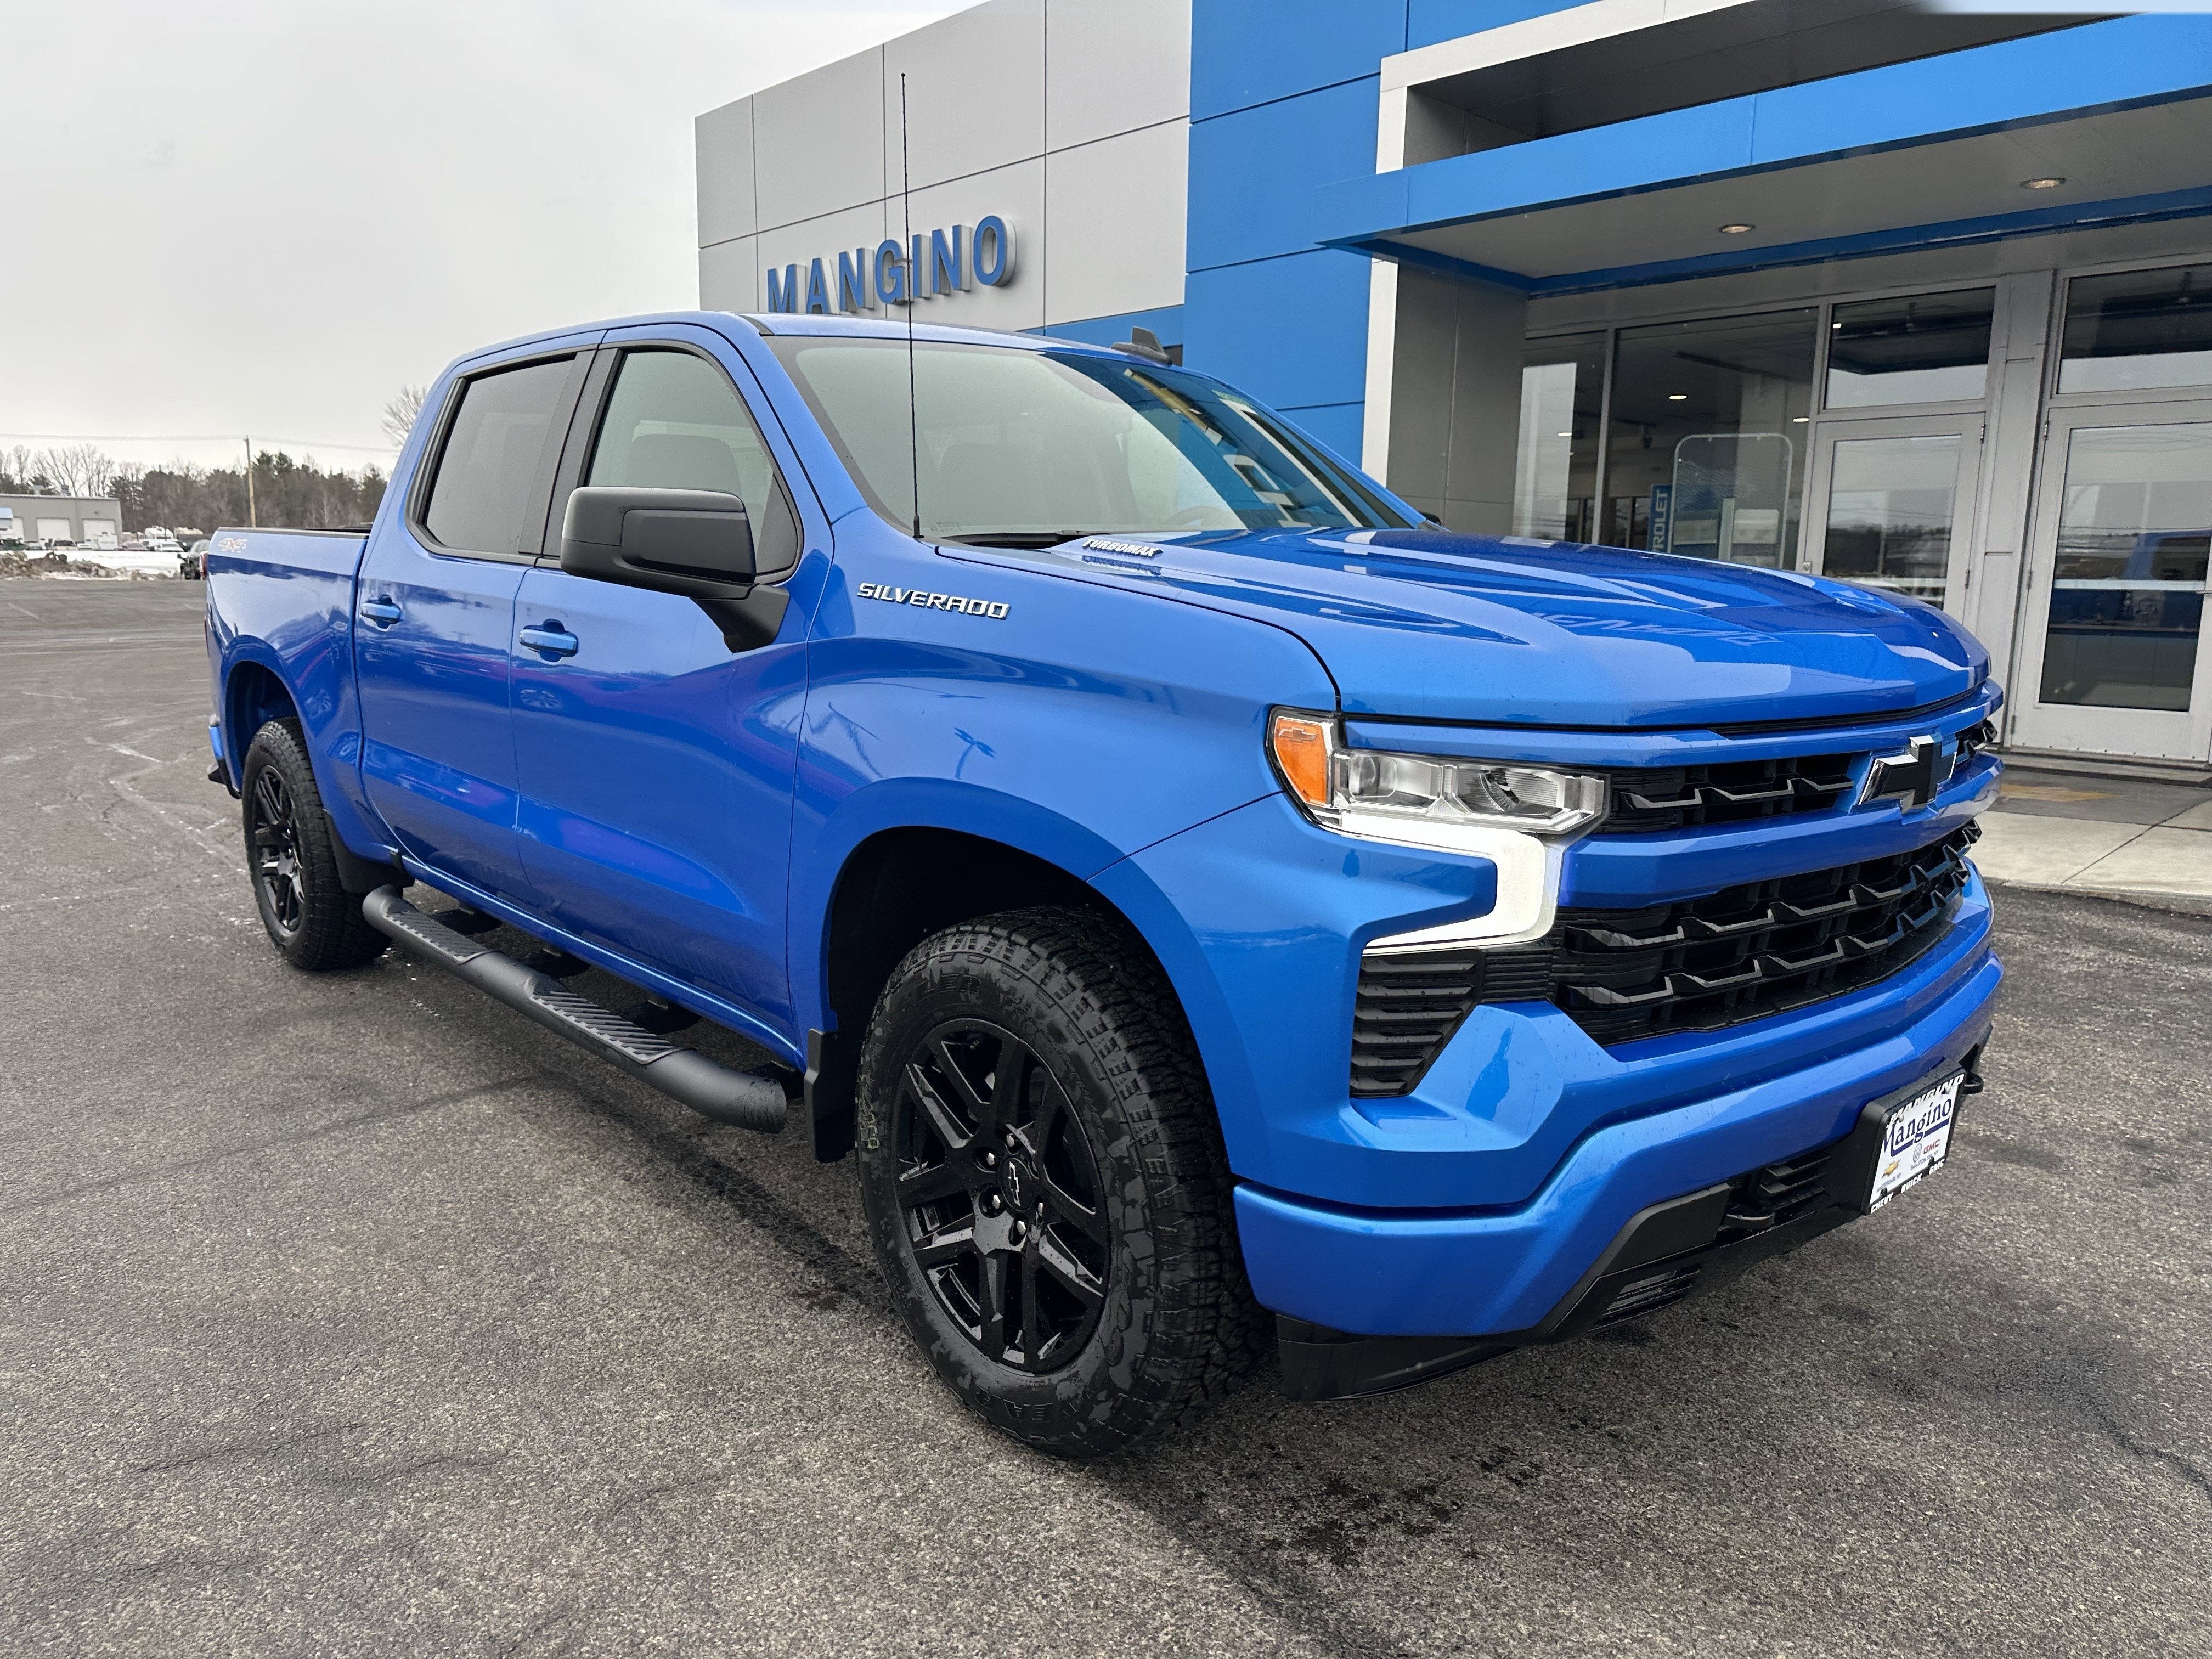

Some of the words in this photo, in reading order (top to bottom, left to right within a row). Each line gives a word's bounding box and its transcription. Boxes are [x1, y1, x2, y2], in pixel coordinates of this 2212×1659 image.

[768, 215, 1015, 314] MANGINO
[1653, 489, 1668, 551] ROLET
[1082, 539, 1160, 558] TURBOMAX
[857, 582, 1011, 620] SILVERADO
[1883, 1098, 1952, 1156] Mangino
[1923, 1139, 1940, 1154] GMC
[1871, 1192, 1894, 1214] CHEVY
[1901, 1173, 1922, 1194] BUICK
[1929, 1159, 1945, 1175] GMC
